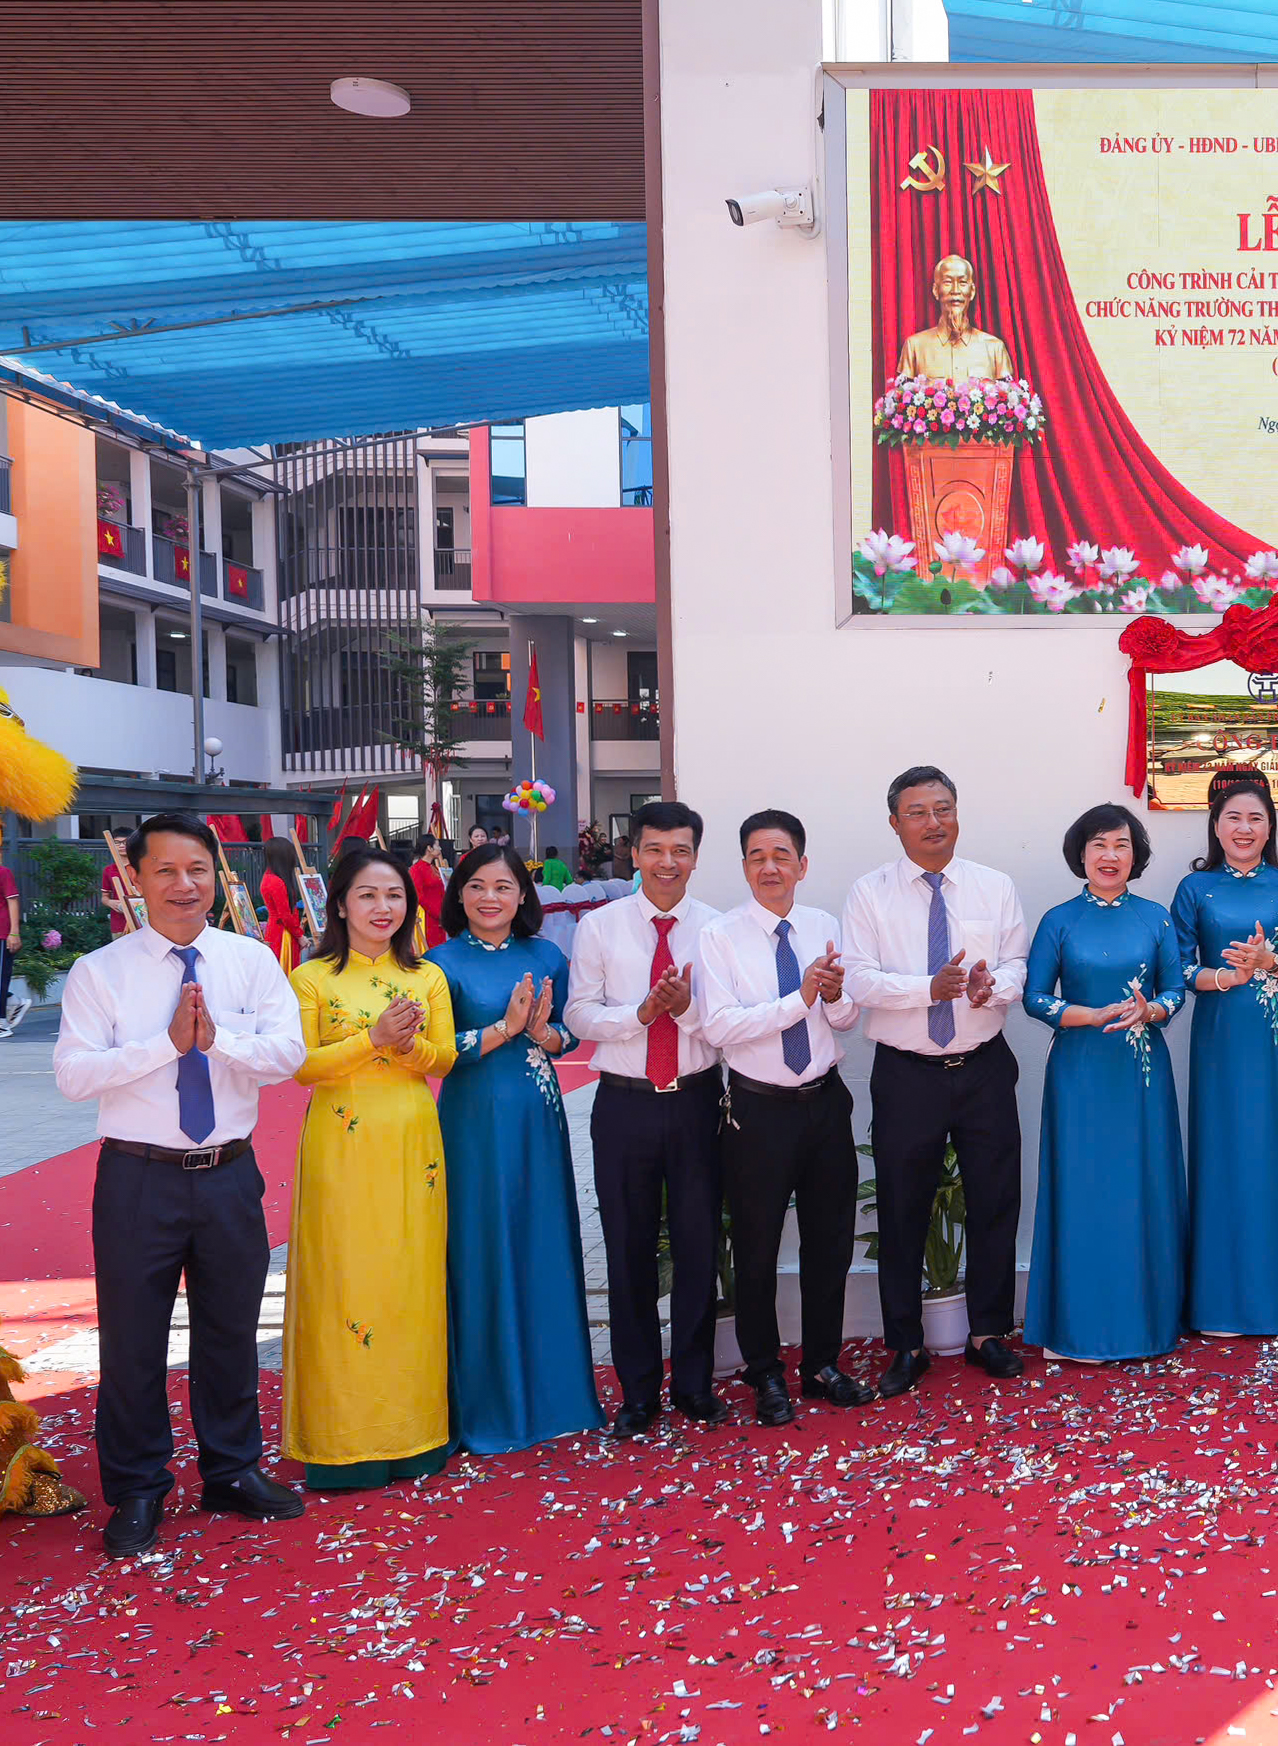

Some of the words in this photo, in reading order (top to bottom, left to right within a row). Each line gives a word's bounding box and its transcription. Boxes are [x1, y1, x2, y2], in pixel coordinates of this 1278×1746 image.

[1100, 132, 1147, 154] ĐẢNG
[1151, 132, 1174, 154] ỦY
[1189, 137, 1238, 153] HĐND
[1126, 268, 1175, 290] CÔNG
[1179, 267, 1232, 290] TRÌNH
[1236, 267, 1266, 290] CẢI
[1085, 297, 1132, 318] CHỨC
[1134, 297, 1182, 318] NĂNG
[1184, 297, 1254, 318] TRƯỜNG
[1154, 324, 1178, 347] KỶ
[1181, 326, 1224, 349] NIỆM
[1228, 329, 1246, 346] 72
[1197, 728, 1261, 751] CÔNG
